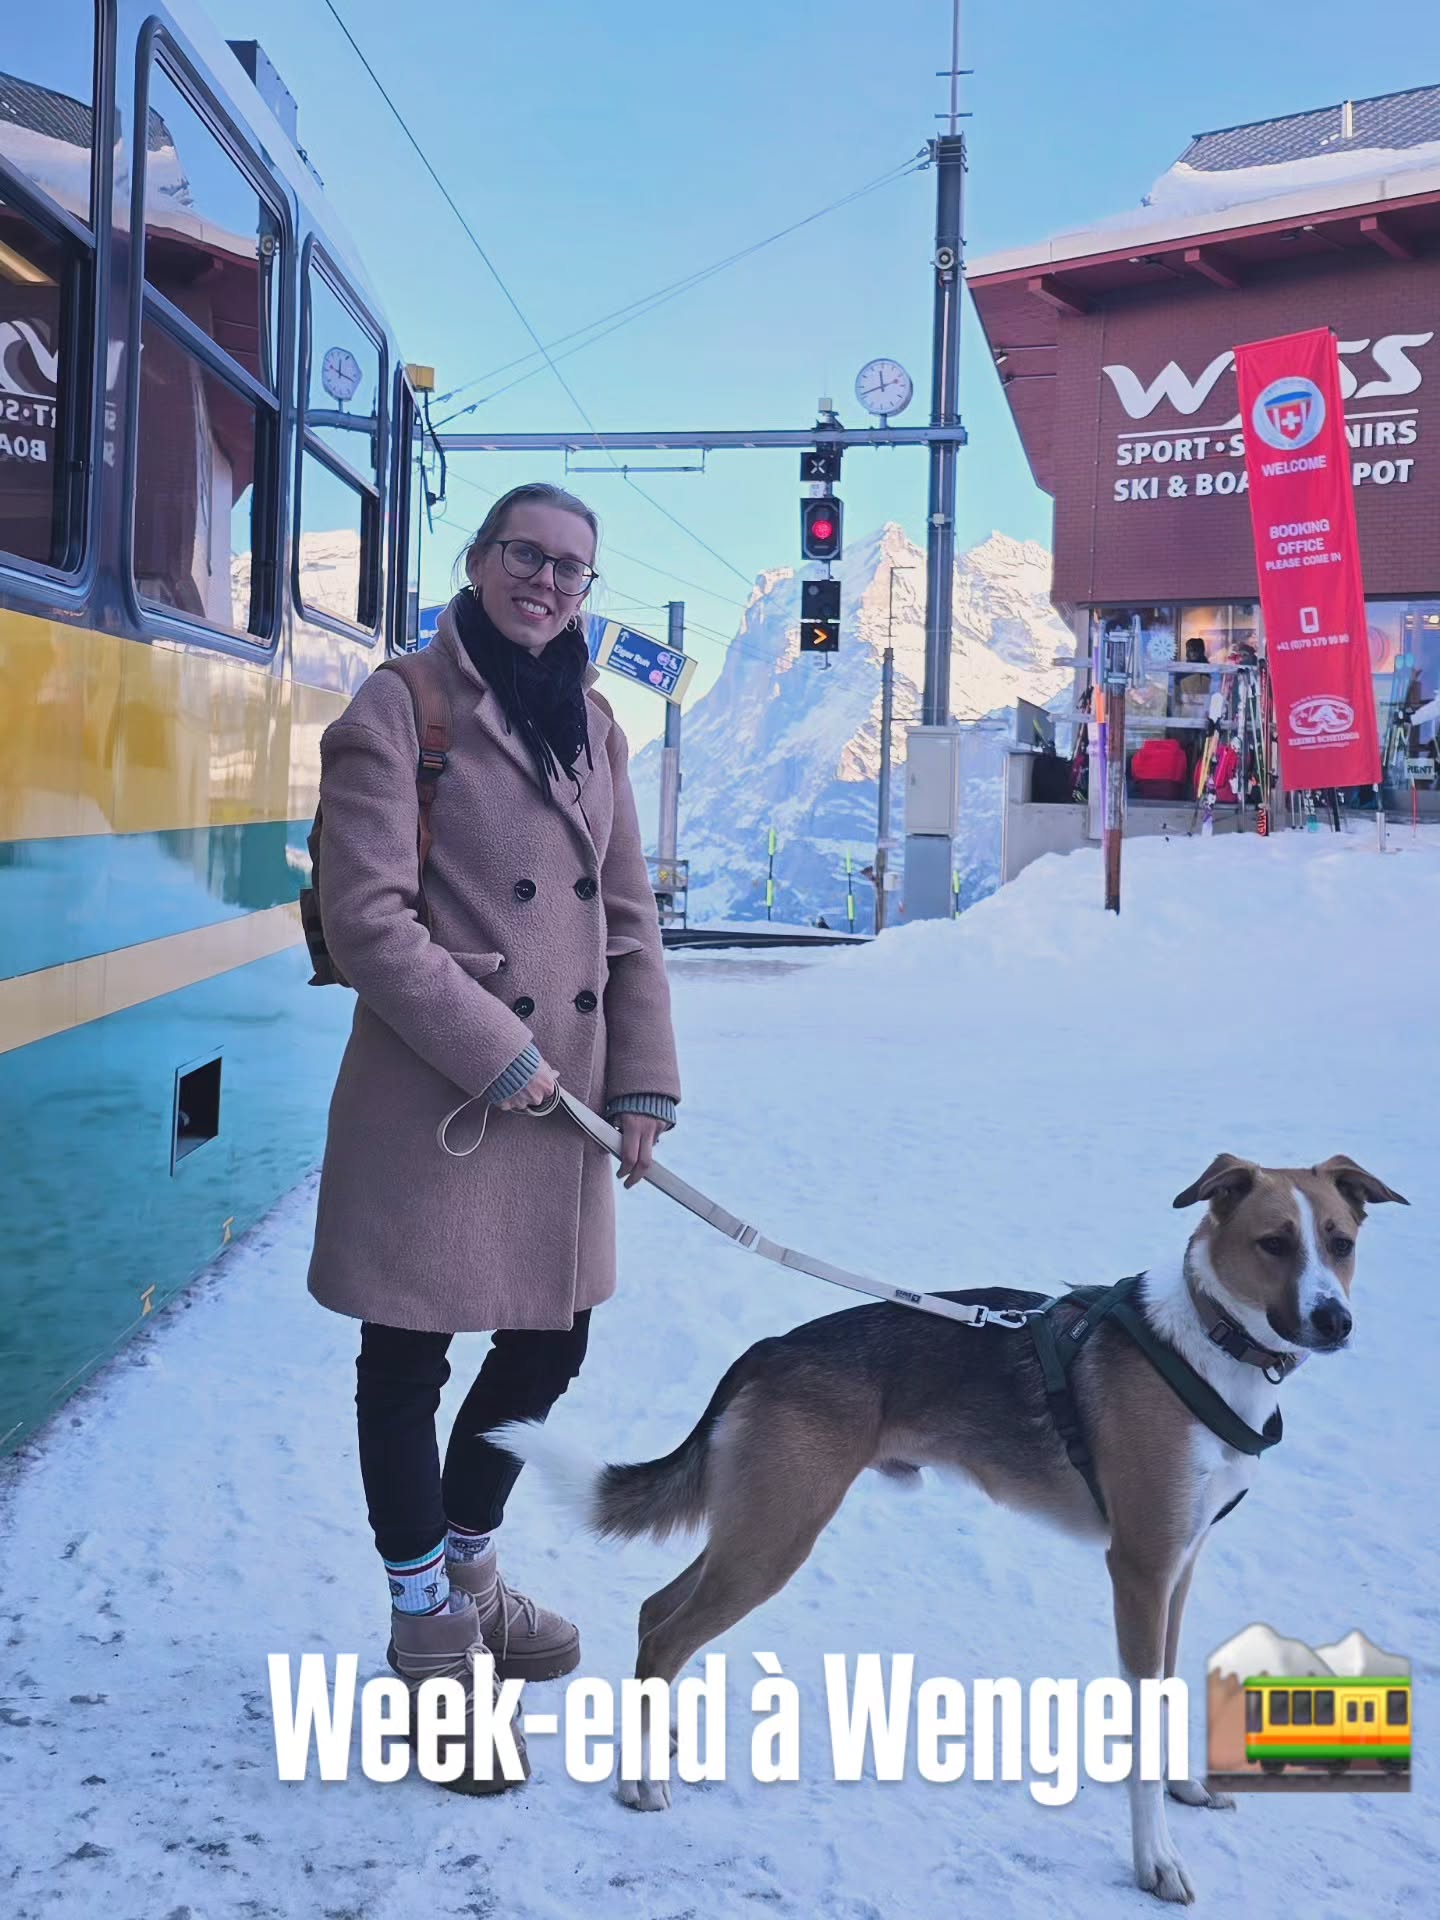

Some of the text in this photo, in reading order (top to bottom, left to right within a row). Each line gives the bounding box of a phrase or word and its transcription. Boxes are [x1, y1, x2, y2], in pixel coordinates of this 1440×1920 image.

[1261, 455, 1327, 477] WELCOME
[1113, 459, 1415, 502] SKI & BOA POT
[1269, 519, 1330, 539] BOOKING
[1277, 537, 1325, 555] OFFICE
[1265, 552, 1342, 571] PLEASE COME IN
